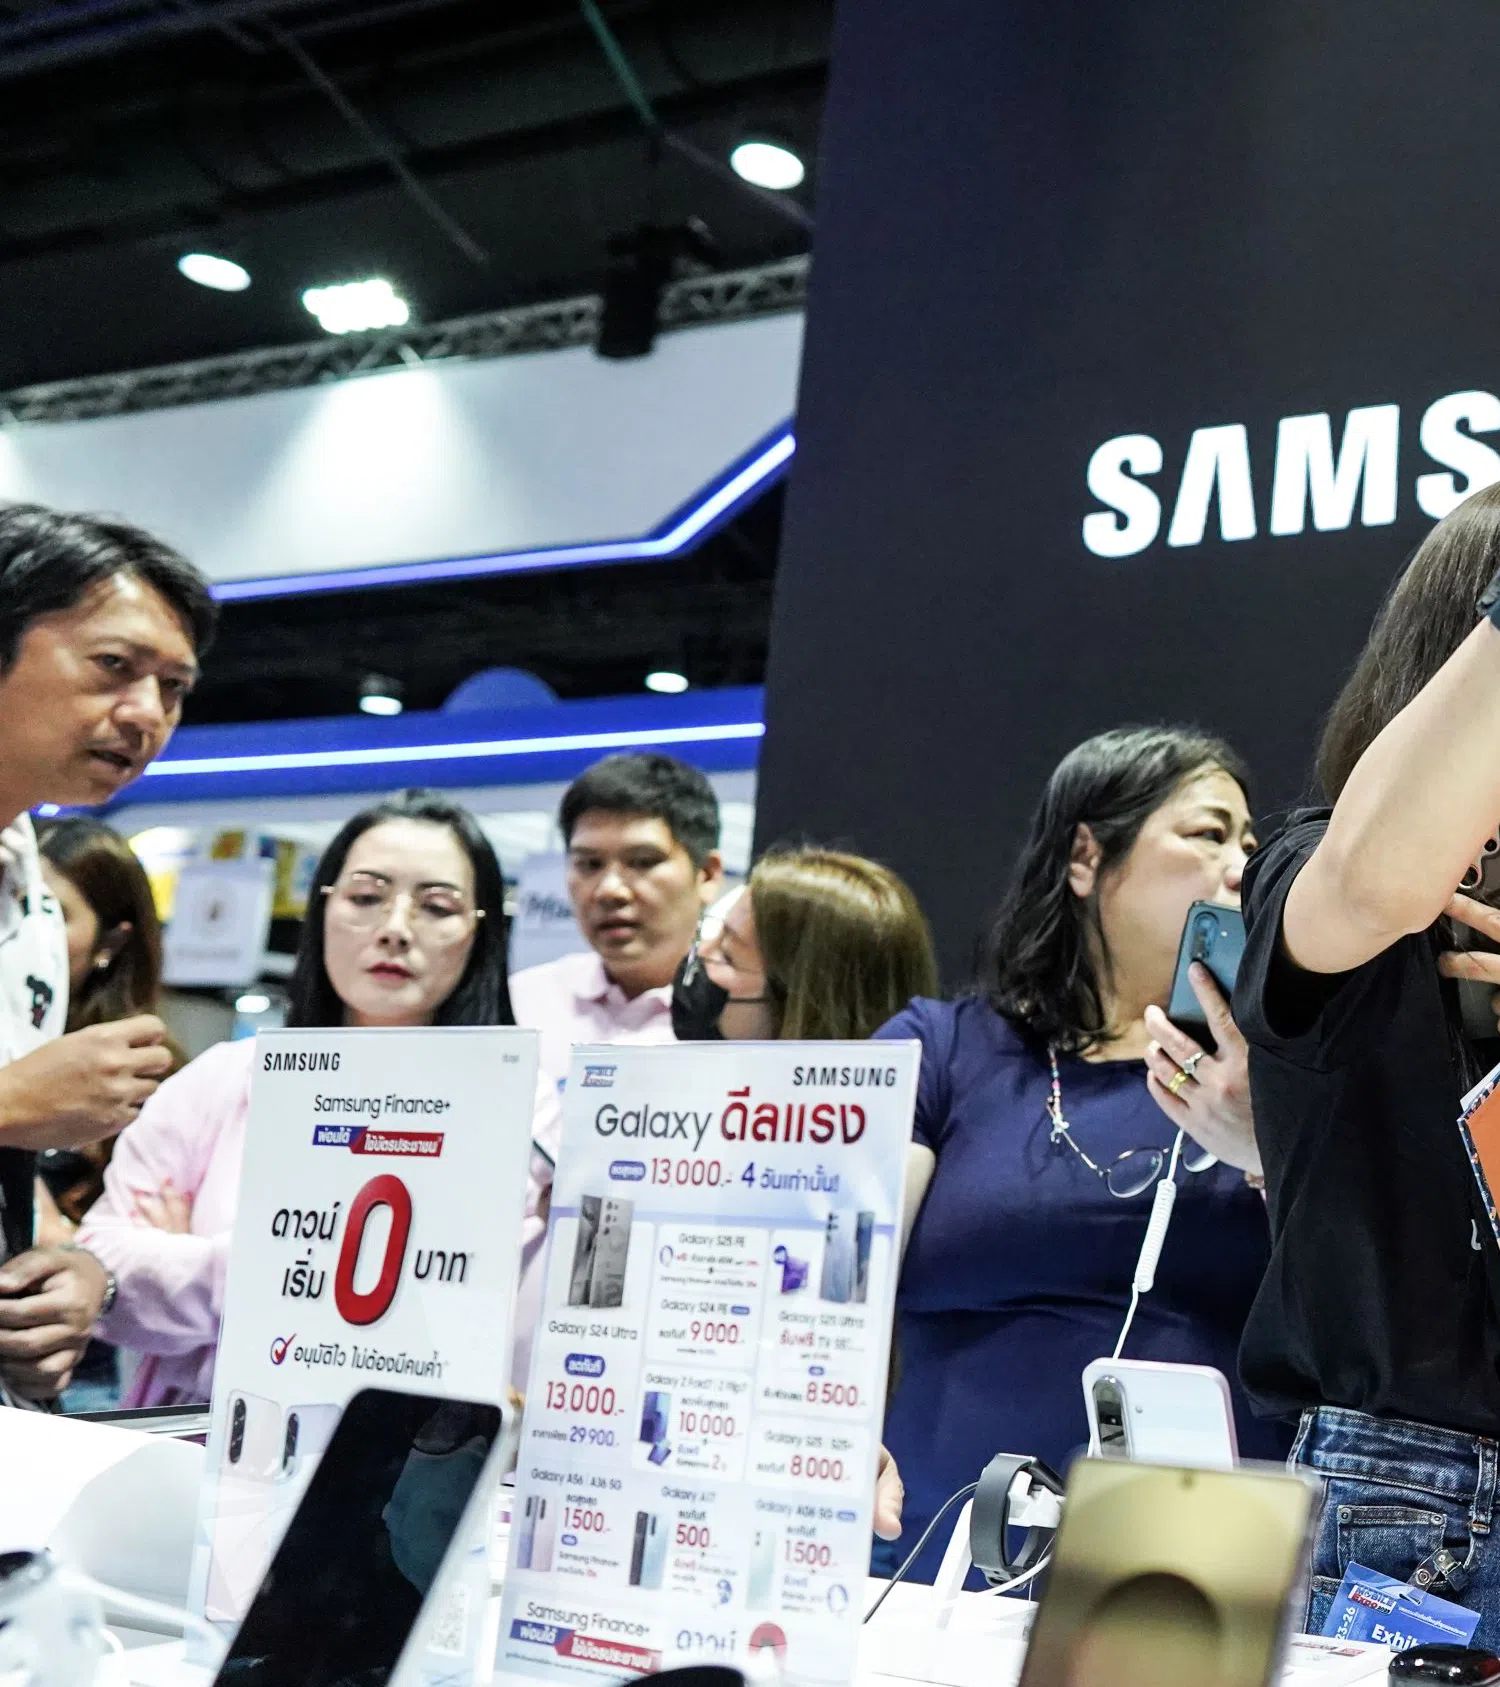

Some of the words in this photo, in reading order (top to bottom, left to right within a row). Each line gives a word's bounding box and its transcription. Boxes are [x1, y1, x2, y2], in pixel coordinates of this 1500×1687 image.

[264, 1053, 341, 1071] SAMSUNG
[792, 1066, 897, 1087] SAMSUNG
[314, 1095, 381, 1119] Samsung
[385, 1094, 450, 1114] Finance+
[595, 1103, 712, 1152] Galaxy
[721, 1086, 866, 1145] ดีลแรง
[741, 1161, 756, 1188] 4
[271, 1201, 341, 1241] ดาวน์
[282, 1248, 325, 1299] เริ่ม
[335, 1173, 413, 1326] 0
[414, 1249, 467, 1283] บาท
[548, 1320, 587, 1339] Galaxy
[590, 1323, 608, 1337] S24
[611, 1325, 638, 1340] Ultra
[294, 1343, 347, 1369] อนุมัติไว
[352, 1345, 443, 1378] ไม่ต้องมีคนค้ำ
[531, 1467, 565, 1484] Galaxy
[1355, 1585, 1396, 1608] MOBILE
[527, 1601, 588, 1631] Samsung
[591, 1612, 650, 1637] Finance+
